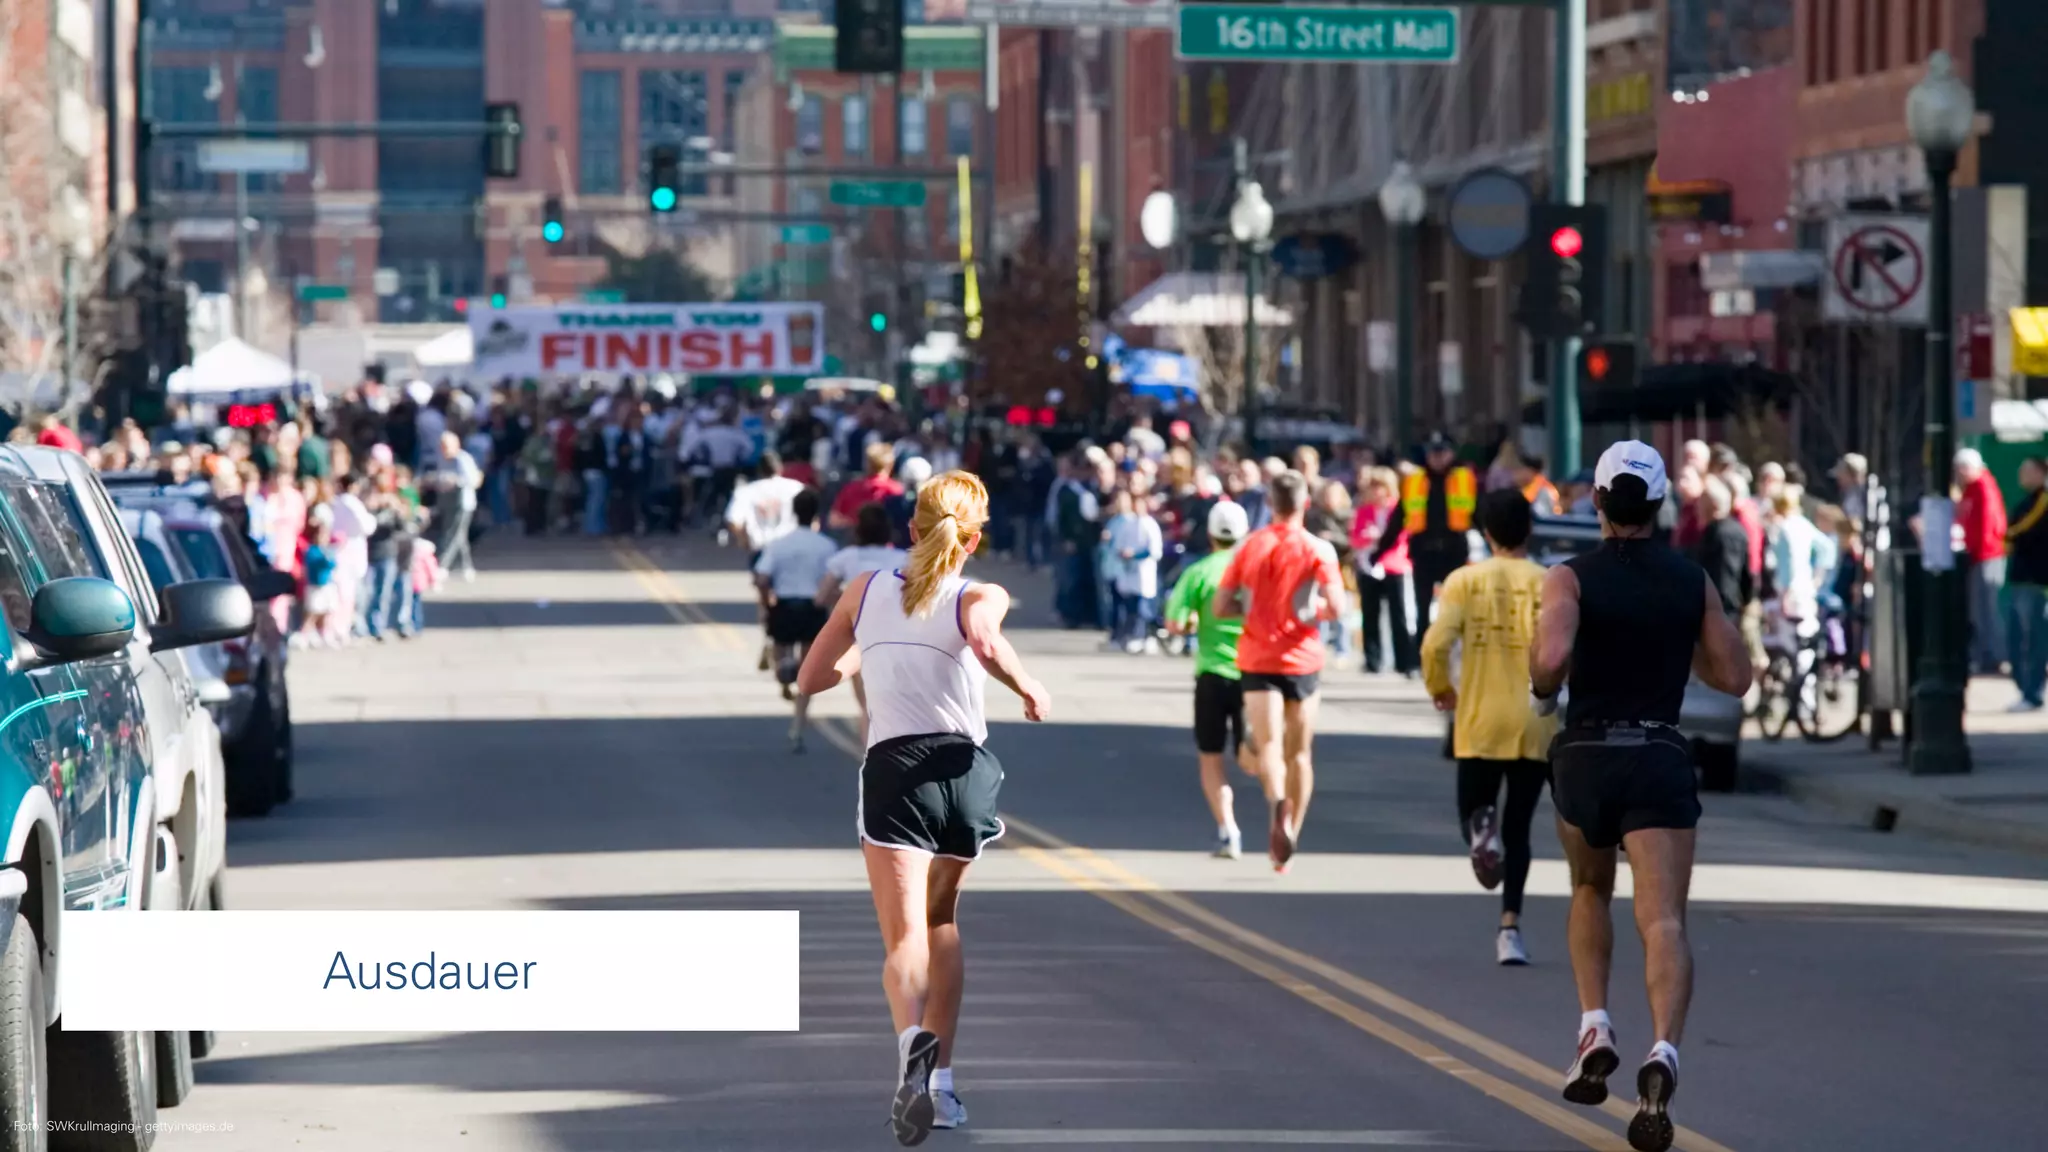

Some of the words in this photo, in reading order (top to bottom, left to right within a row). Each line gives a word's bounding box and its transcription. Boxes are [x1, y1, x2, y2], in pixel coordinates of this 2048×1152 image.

[1217, 16, 1287, 49] 16th
[1295, 16, 1385, 50] Street
[1393, 20, 1449, 49] Mall
[558, 312, 675, 327] THANK
[691, 312, 763, 326] YOU
[541, 331, 774, 370] FINISH
